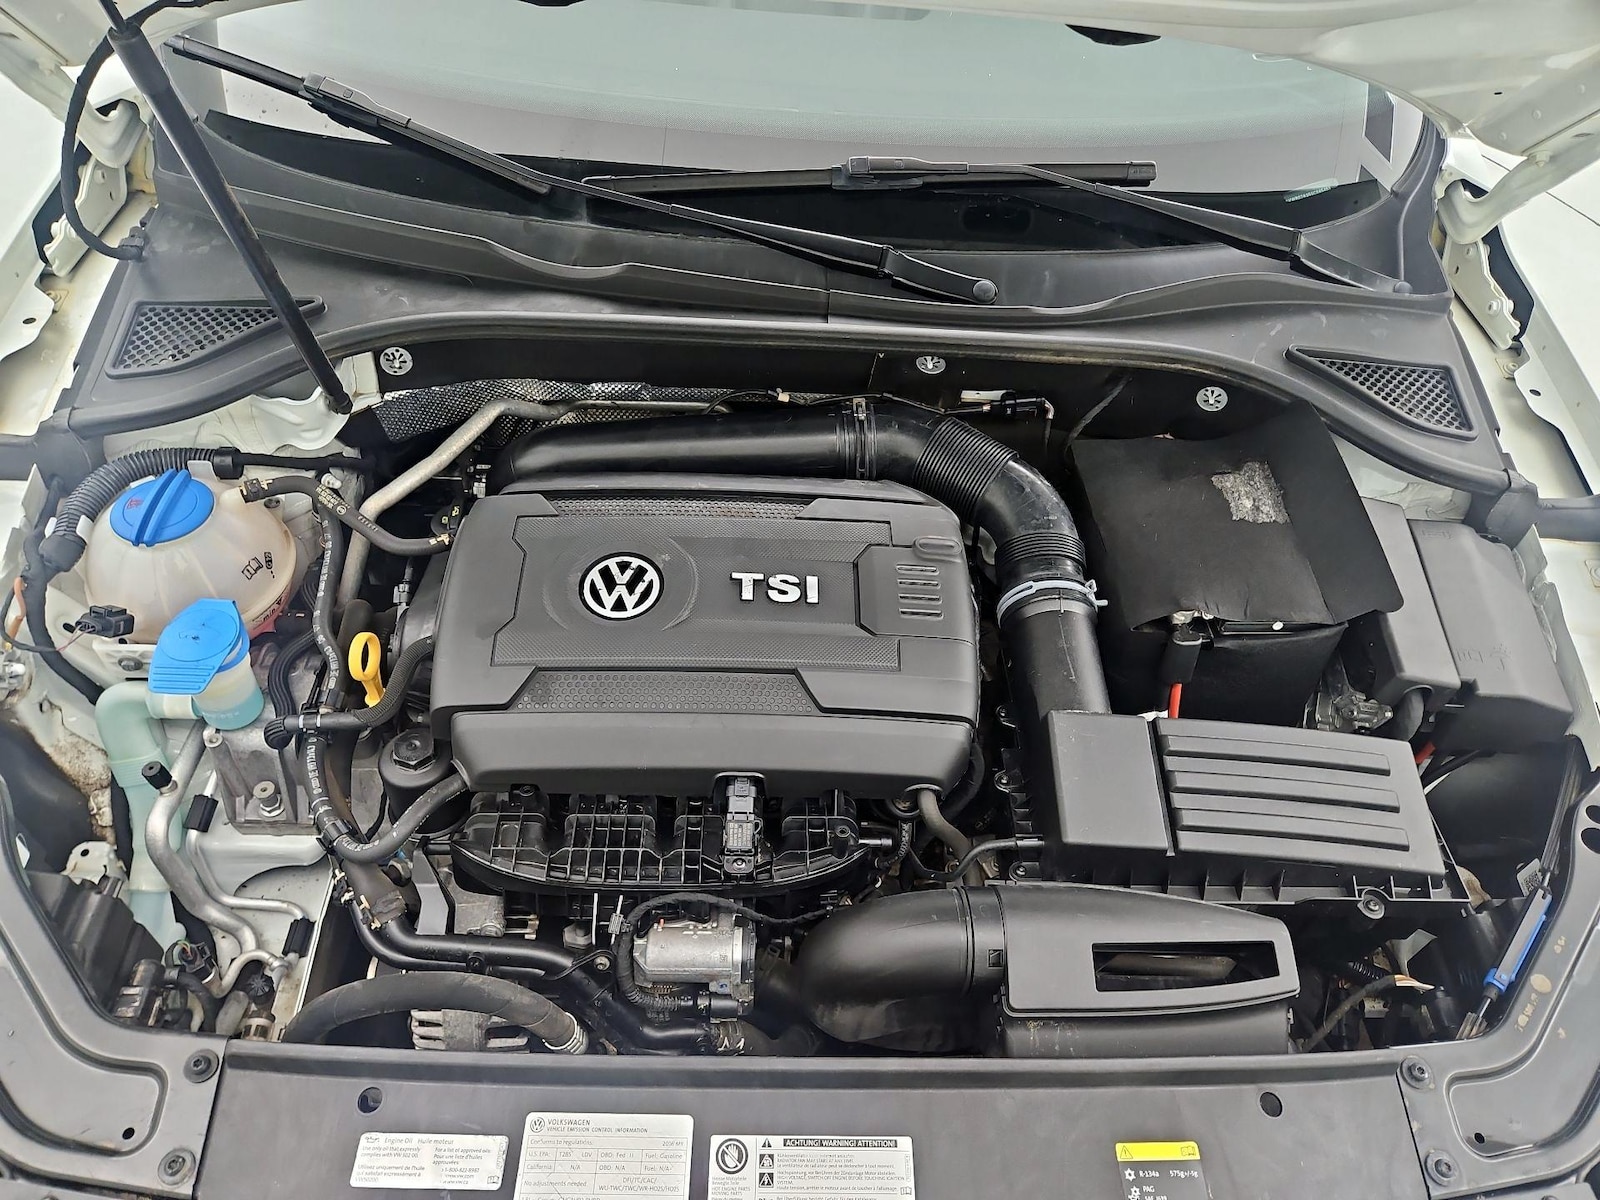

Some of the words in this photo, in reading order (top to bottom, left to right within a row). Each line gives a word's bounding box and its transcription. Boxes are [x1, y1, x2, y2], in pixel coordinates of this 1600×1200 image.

[731, 572, 819, 604] TSI
[547, 1118, 591, 1126] VOLKSWAGEN
[384, 1138, 404, 1146] Engine
[785, 1139, 820, 1147] ACHTUNG!
[857, 1140, 895, 1148] ATTENTION!
[614, 1164, 626, 1172] N/A
[1139, 1170, 1160, 1178] R-134a
[532, 1180, 566, 1188] adjustments
[1142, 1185, 1155, 1193] PAG
